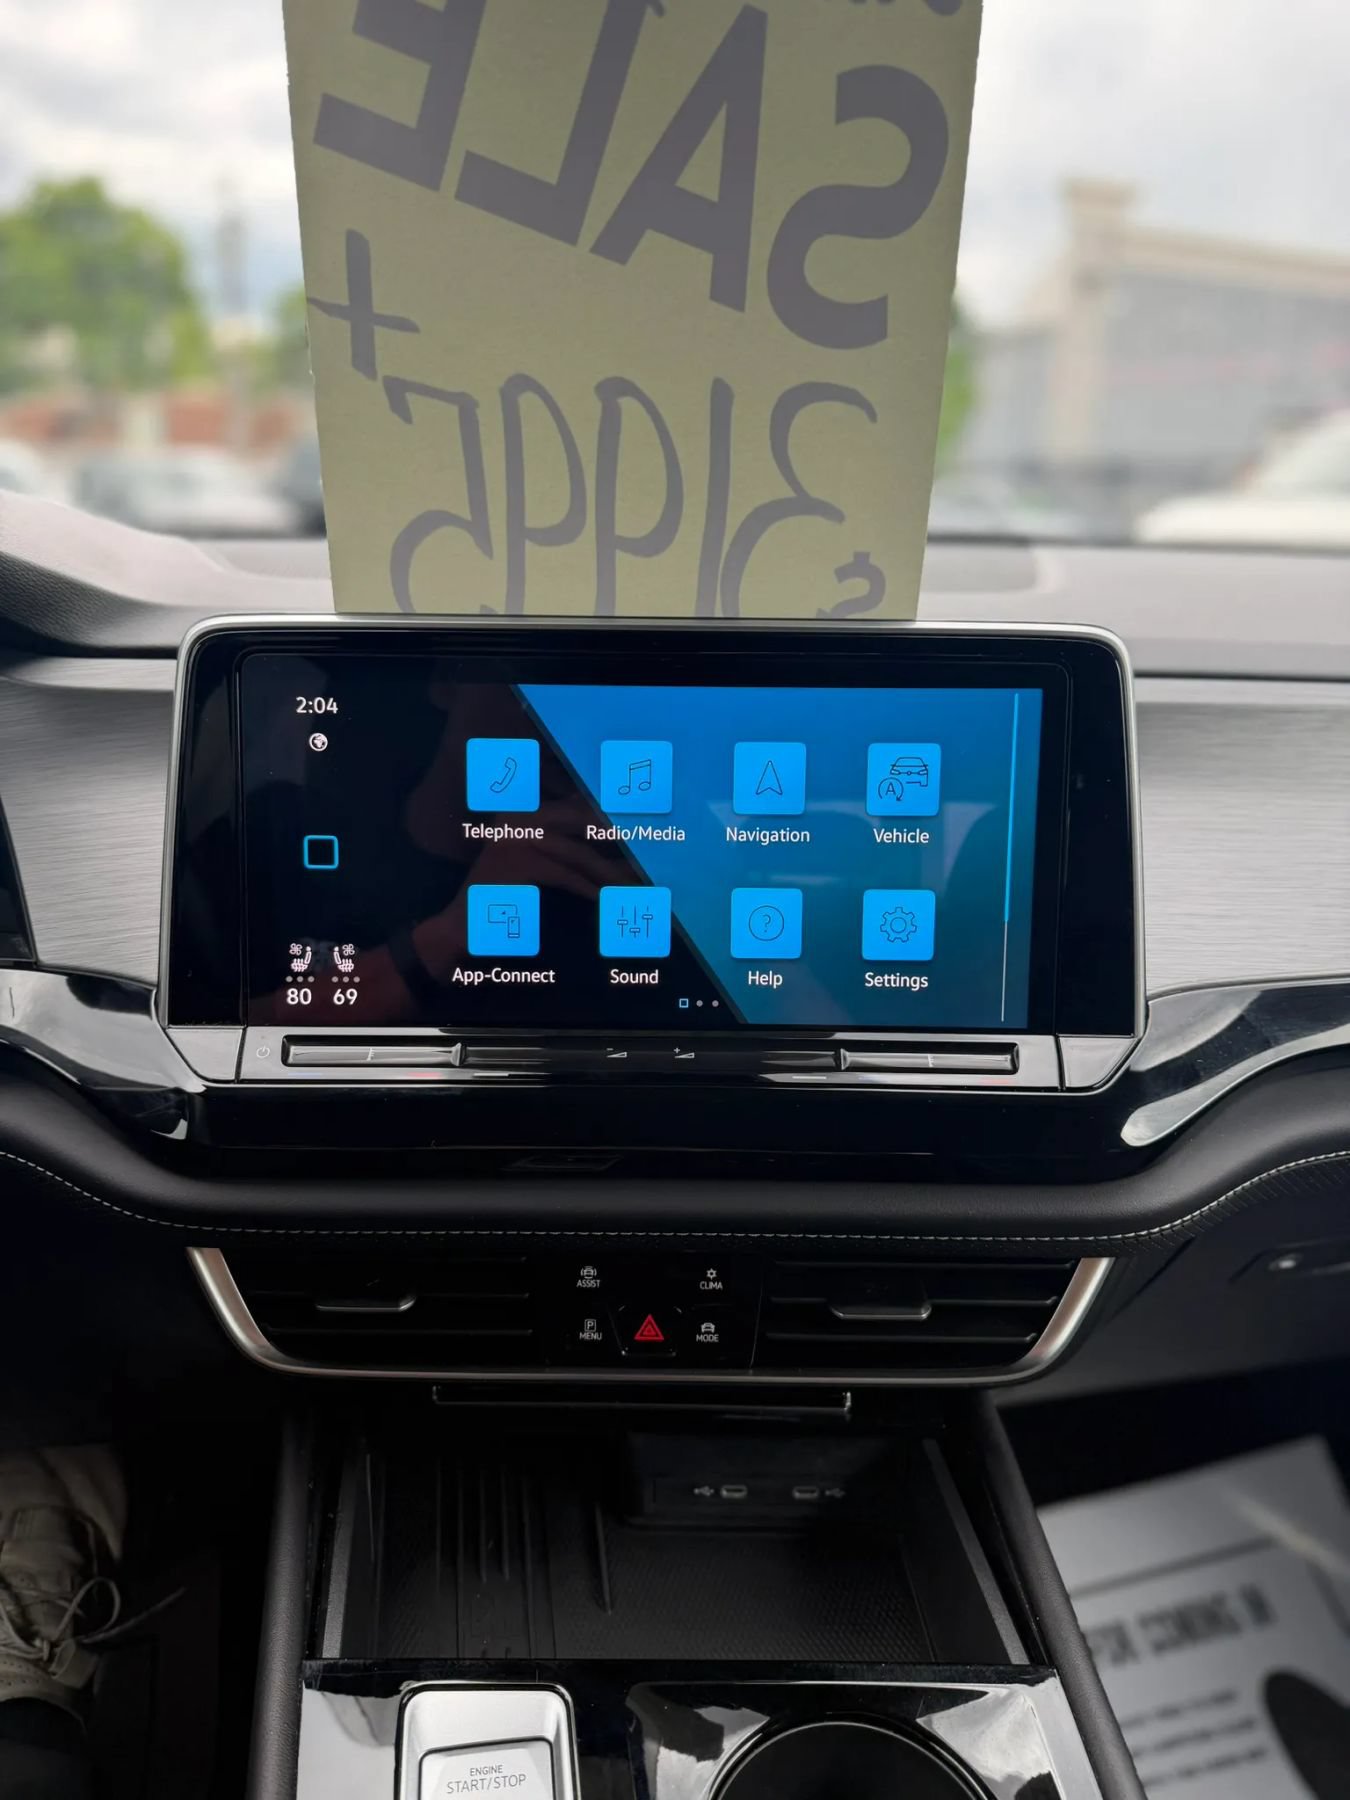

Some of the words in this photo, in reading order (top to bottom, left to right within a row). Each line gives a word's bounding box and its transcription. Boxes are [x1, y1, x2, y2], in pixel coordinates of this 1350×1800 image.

[295, 696, 339, 715] 2:04
[462, 823, 544, 842] Telephone
[586, 824, 686, 842] Radio/Media
[726, 826, 810, 846] Navigation
[873, 828, 930, 844] Vehicle
[452, 966, 556, 988] App-Connect
[610, 968, 659, 985] Sound
[747, 970, 783, 990] Help
[864, 971, 929, 991] Settings
[286, 987, 312, 1006] 80
[333, 987, 358, 1006] 69
[576, 1279, 601, 1288] ASSIST
[699, 1281, 723, 1290] CLIMA
[579, 1332, 602, 1340] MENU
[696, 1334, 719, 1342] MODE
[469, 1764, 504, 1776] ENGINE
[446, 1773, 527, 1794] START/STOP
